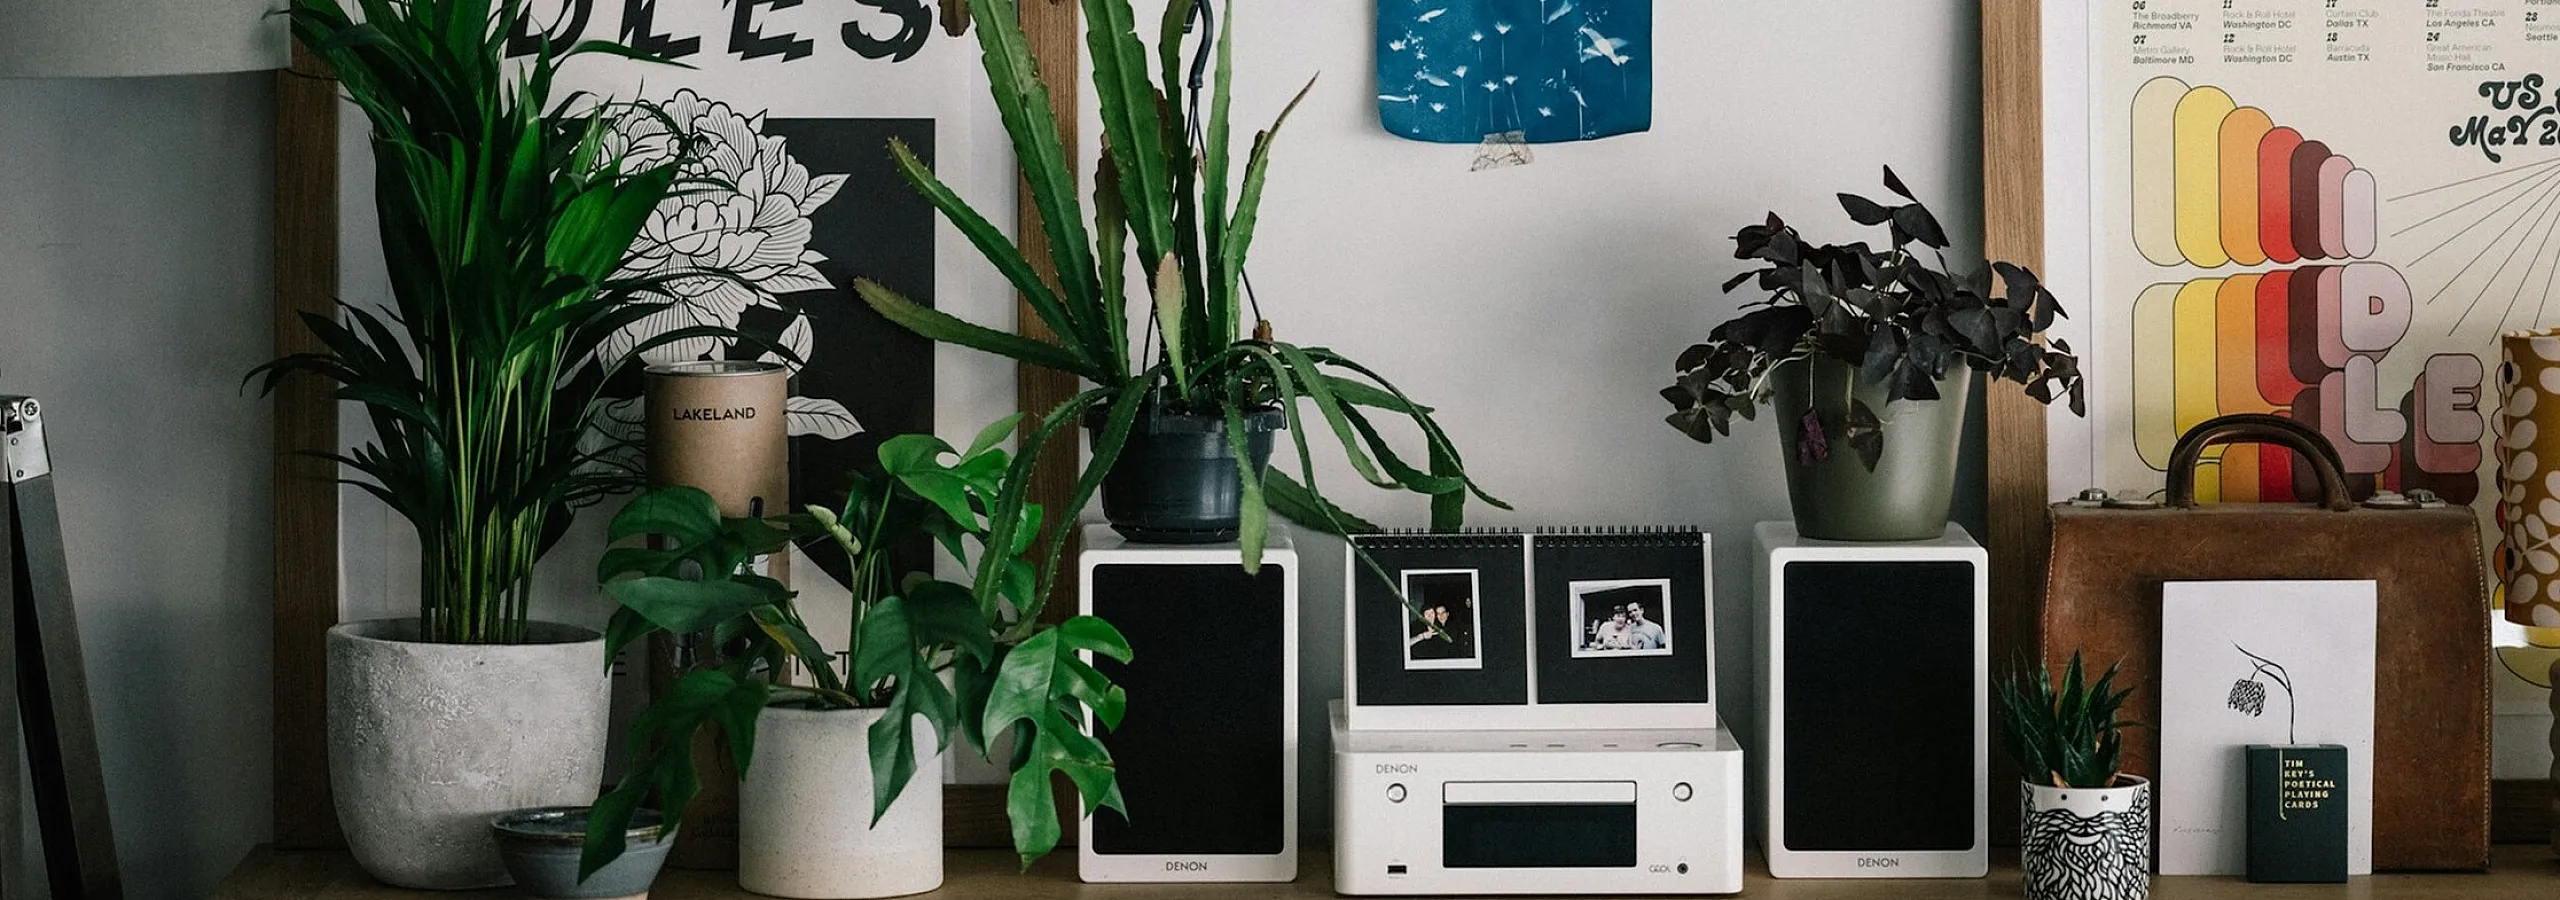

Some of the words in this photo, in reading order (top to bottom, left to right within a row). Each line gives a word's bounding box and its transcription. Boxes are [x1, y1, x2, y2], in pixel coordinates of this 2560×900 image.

[2133, 0, 2146, 10] 06
[2223, 0, 2232, 9] 11
[2326, 0, 2338, 8] 17
[2133, 12, 2149, 20] The
[2132, 21, 2177, 30] Richmond
[2178, 21, 2193, 30] VA
[2223, 20, 2277, 31] Washington
[2278, 20, 2293, 29] DC
[2326, 19, 2354, 28] Dallas
[2356, 19, 2369, 28] TX
[2426, 19, 2442, 28] Los
[2444, 19, 2480, 30] Angeles
[2481, 18, 2496, 28] CA
[2133, 34, 2147, 45] 07
[2223, 33, 2235, 44] 12
[2426, 32, 2441, 42] 24
[2525, 32, 2558, 42] Seattle
[2133, 56, 2177, 64] Baltimore
[2178, 55, 2195, 64] MD
[2223, 54, 2278, 65] Washington
[2278, 54, 2294, 63] DC
[2327, 53, 2356, 62] Austin
[2357, 53, 2371, 62] TX
[2427, 62, 2444, 72] San
[2446, 62, 2490, 72] Francisco
[2491, 62, 2506, 72] CA
[673, 407, 756, 421] LAKELAND
[2284, 760, 2303, 768] TIM
[1376, 764, 1418, 775] DENON
[2284, 770, 2315, 778] KEY'S
[2284, 780, 2336, 789] POETICAL
[2284, 790, 2329, 799] PLAYING
[2284, 801, 2319, 809] CARDS
[1165, 861, 1207, 872] DENON
[1857, 858, 1899, 868] DENON
